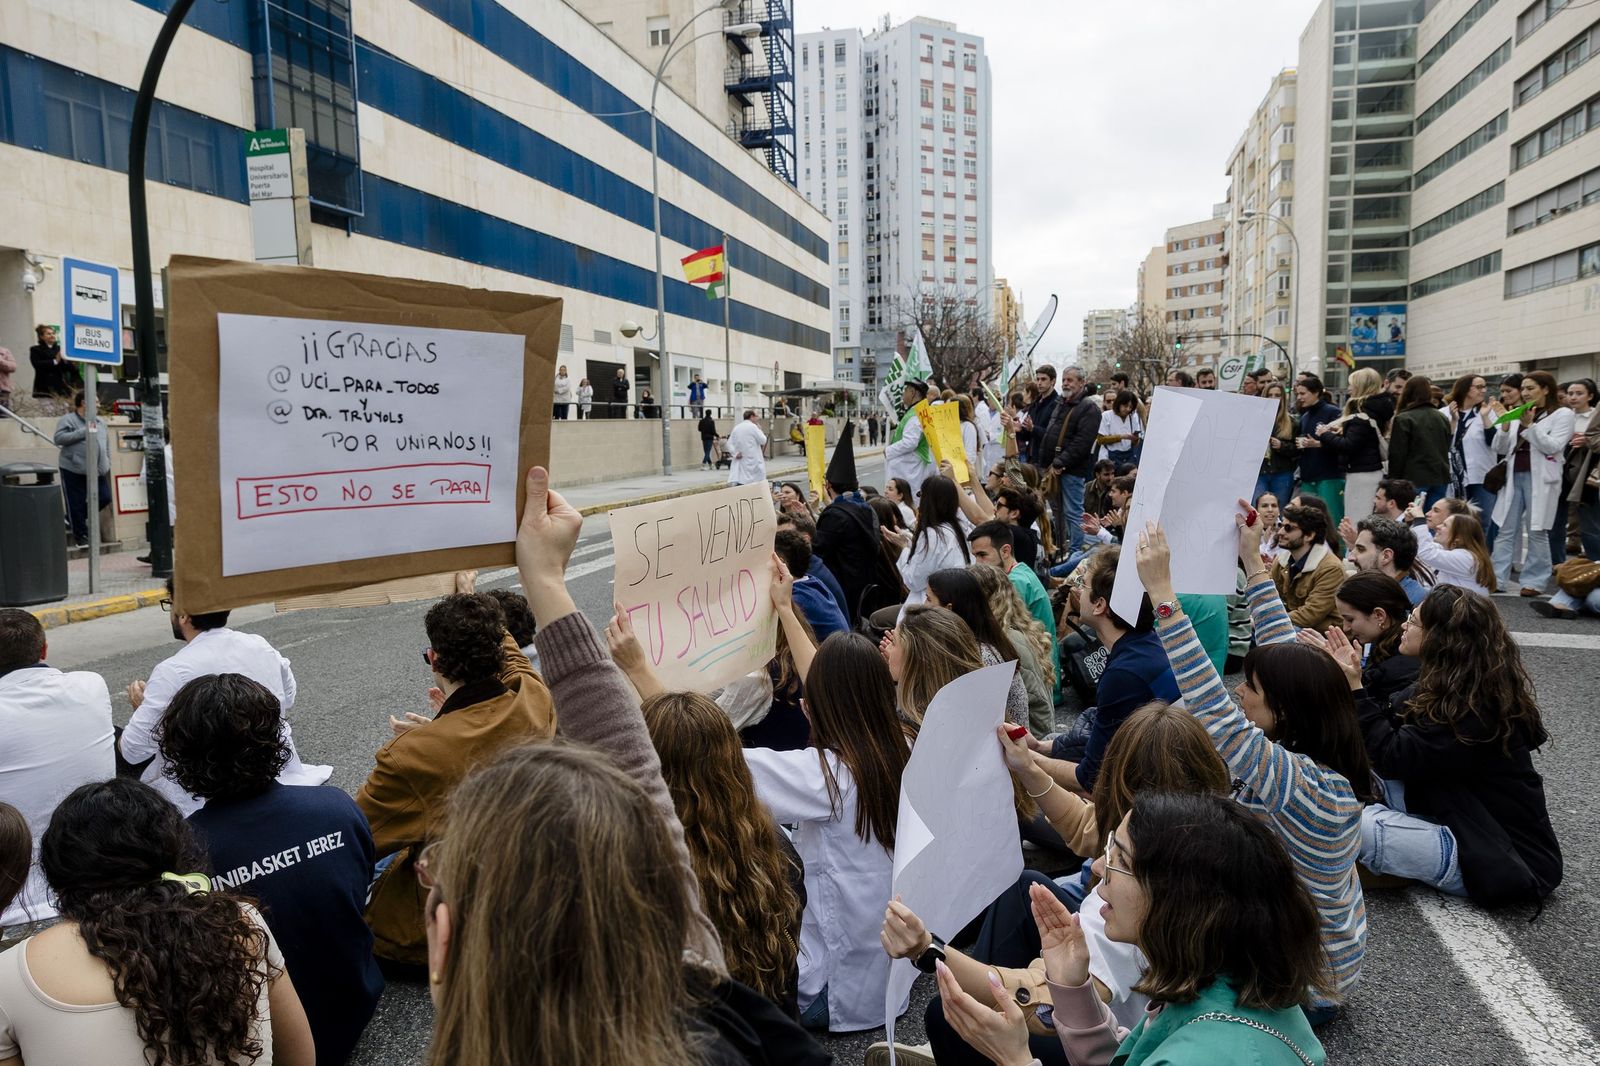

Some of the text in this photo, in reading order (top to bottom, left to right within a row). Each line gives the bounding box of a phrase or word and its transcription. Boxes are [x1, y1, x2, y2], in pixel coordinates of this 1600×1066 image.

[250, 173, 288, 181] Universitario
[76, 337, 111, 348] URBANO
[85, 328, 102, 339] BUS
[1225, 365, 1243, 373] CSIF
[322, 431, 379, 452] POR
[254, 479, 482, 507] ESTO NO SE PARA
[629, 497, 764, 586] SE VENDE
[677, 569, 757, 659] SALUD
[1084, 646, 1107, 668] SPO
[211, 831, 345, 892] INIBASKET JEREZ
